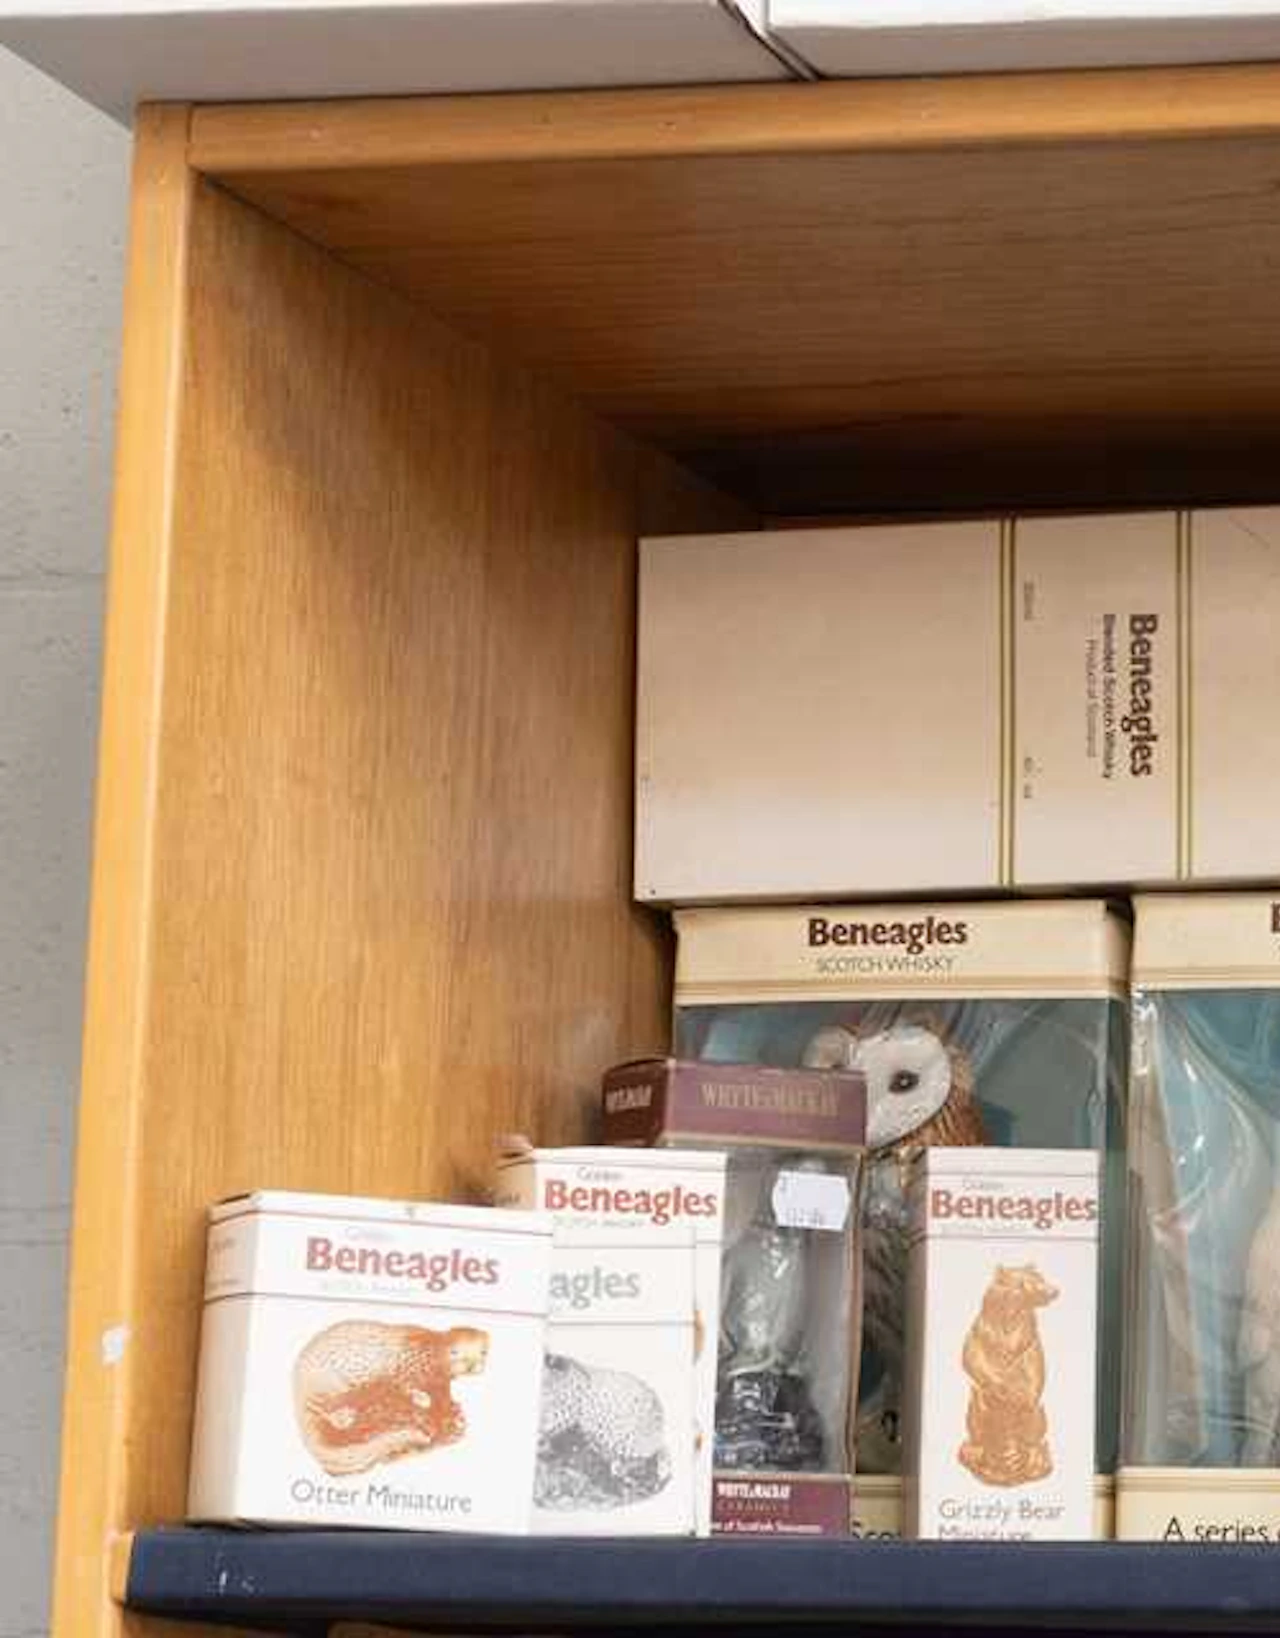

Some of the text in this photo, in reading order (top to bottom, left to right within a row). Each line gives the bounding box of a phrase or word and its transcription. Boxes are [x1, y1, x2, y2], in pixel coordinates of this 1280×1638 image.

[1103, 678, 1117, 728] Scotch
[1121, 613, 1159, 777] Beneagles
[1101, 730, 1117, 778] Whisky
[808, 915, 968, 954] Beneagles
[818, 956, 955, 973] SCOTCH WHISKY
[544, 1179, 717, 1226] Beneagles
[931, 1188, 1097, 1229] Beneagles
[306, 1236, 501, 1292] Beneagles
[549, 1265, 640, 1309] agles
[291, 1478, 473, 1514] Otter Miniature
[938, 1498, 1066, 1525] Grizzly Bear
[1164, 1516, 1185, 1542] A
[1195, 1519, 1268, 1542] series
